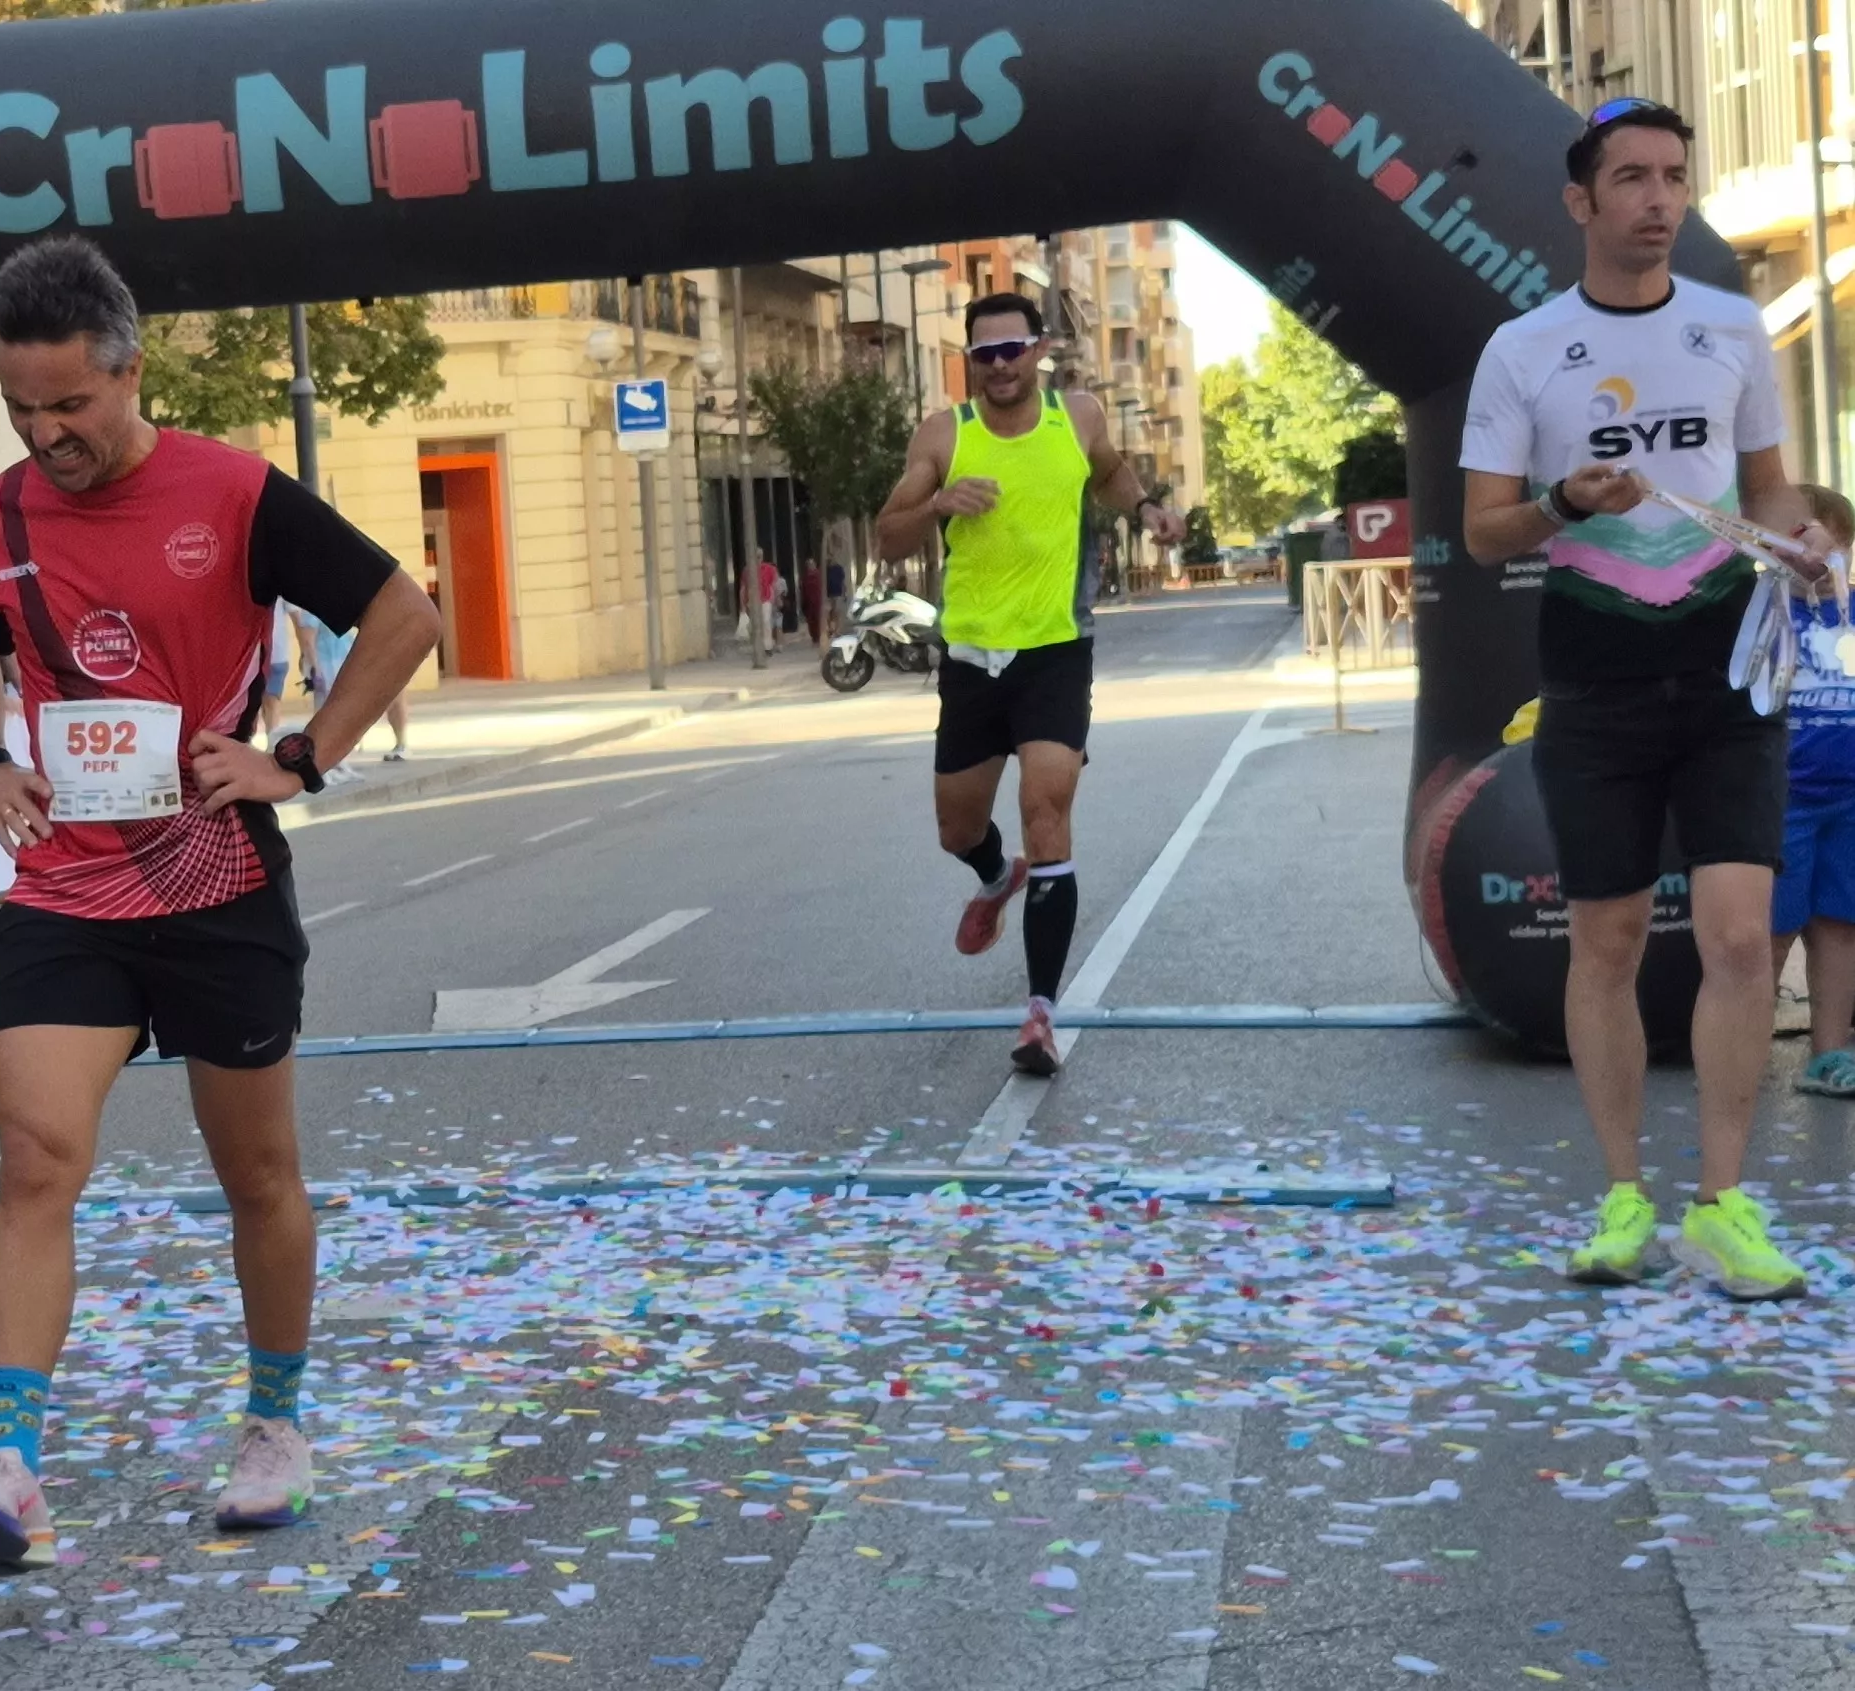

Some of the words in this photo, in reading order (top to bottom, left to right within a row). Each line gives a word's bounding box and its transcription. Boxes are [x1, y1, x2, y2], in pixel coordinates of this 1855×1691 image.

[1588, 417, 1708, 460] SYB
[67, 720, 137, 756] 592
[83, 760, 119, 773] PEPE
